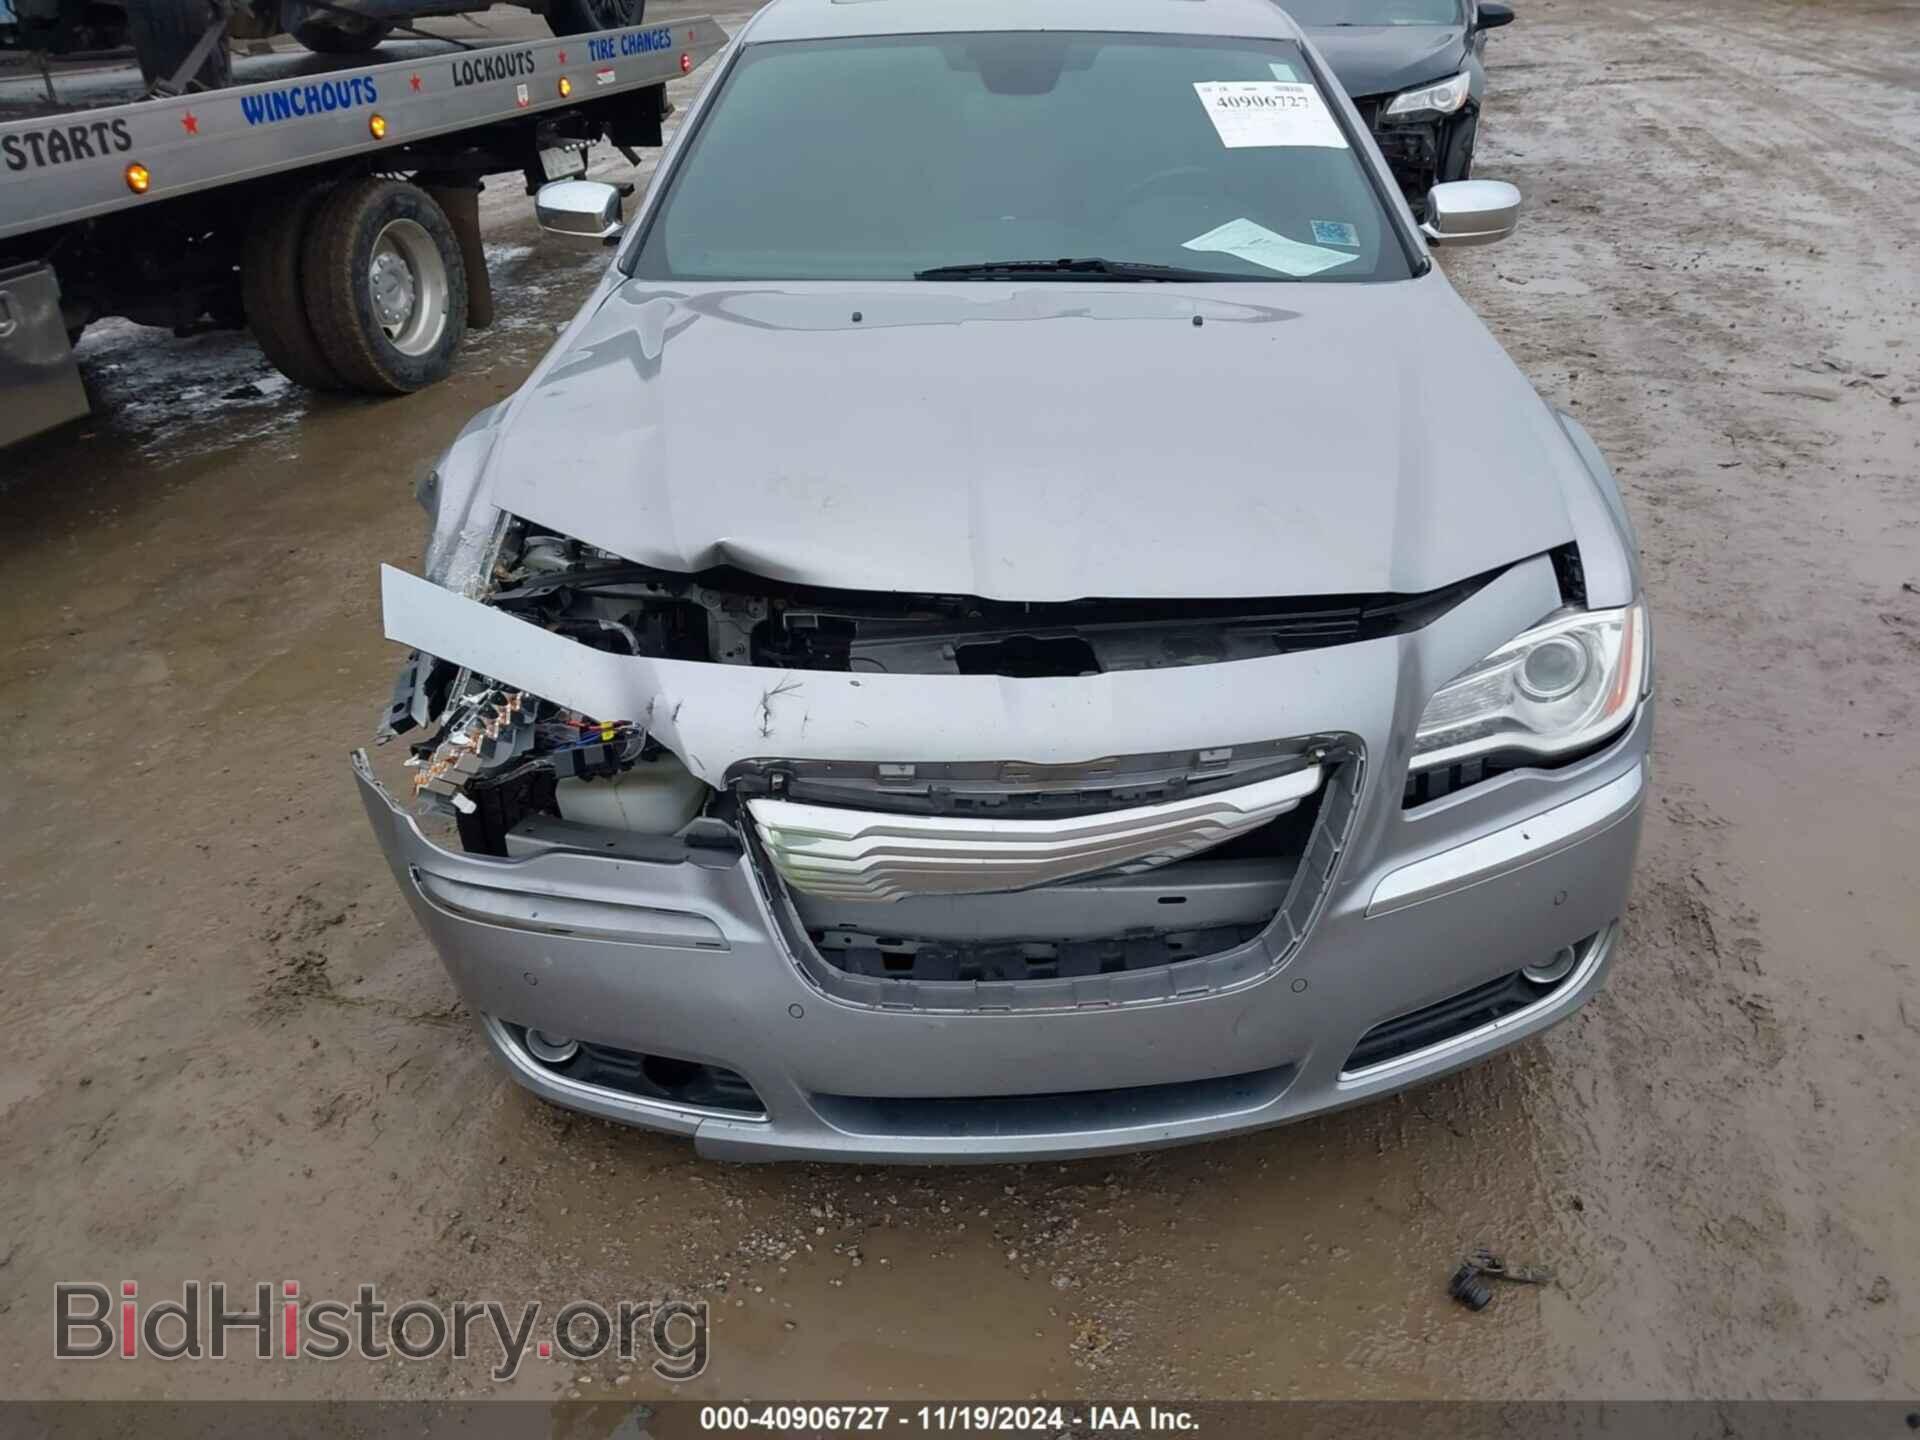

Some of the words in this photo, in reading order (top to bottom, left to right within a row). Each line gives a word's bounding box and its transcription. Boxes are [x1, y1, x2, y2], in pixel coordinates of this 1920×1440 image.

[1, 118, 133, 171] STARTS
[241, 76, 377, 126] WINCHOUTS
[452, 50, 535, 87] LOCKOUTS
[588, 36, 617, 62] TIRE
[621, 28, 672, 56] CHANGES
[1216, 95, 1309, 108] 40906727
